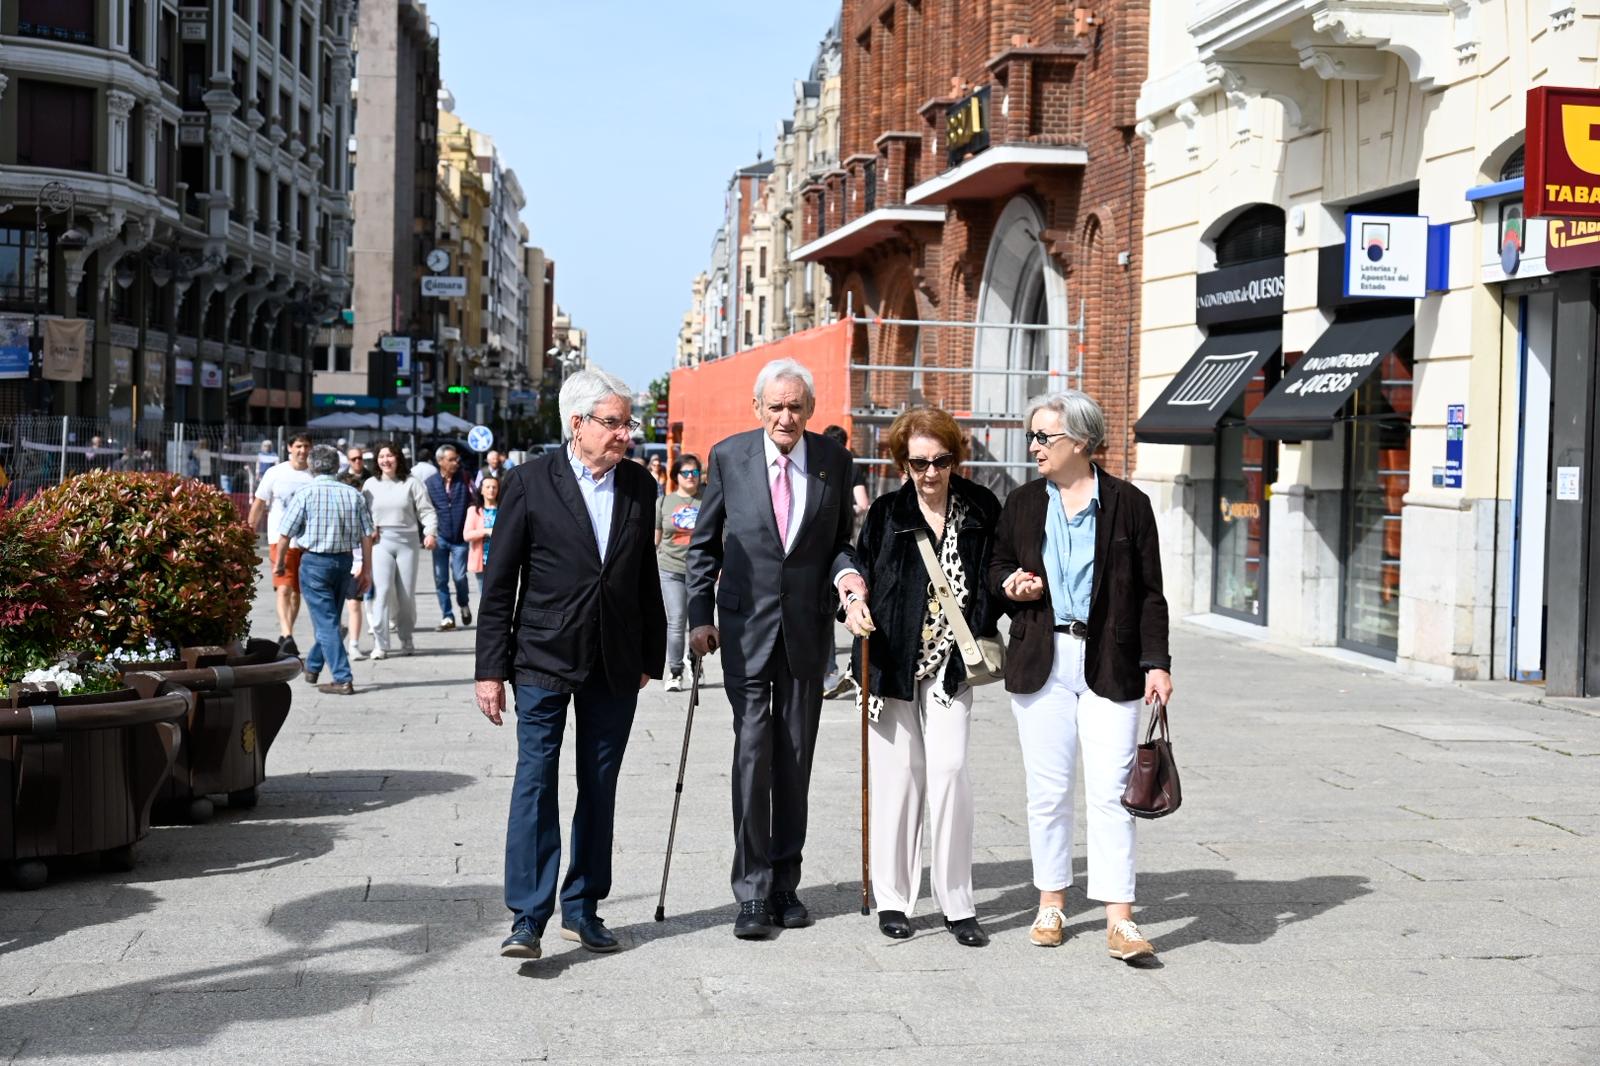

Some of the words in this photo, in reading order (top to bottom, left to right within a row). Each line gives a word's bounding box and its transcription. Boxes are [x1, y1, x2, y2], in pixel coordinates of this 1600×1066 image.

[1546, 184, 1600, 204] TABA
[1361, 274, 1395, 282] Apuestas
[1248, 276, 1285, 304] QUESOS
[1317, 352, 1379, 370] CONTENEDOR
[1285, 378, 1303, 394] de
[1300, 372, 1359, 396] QUESOS
